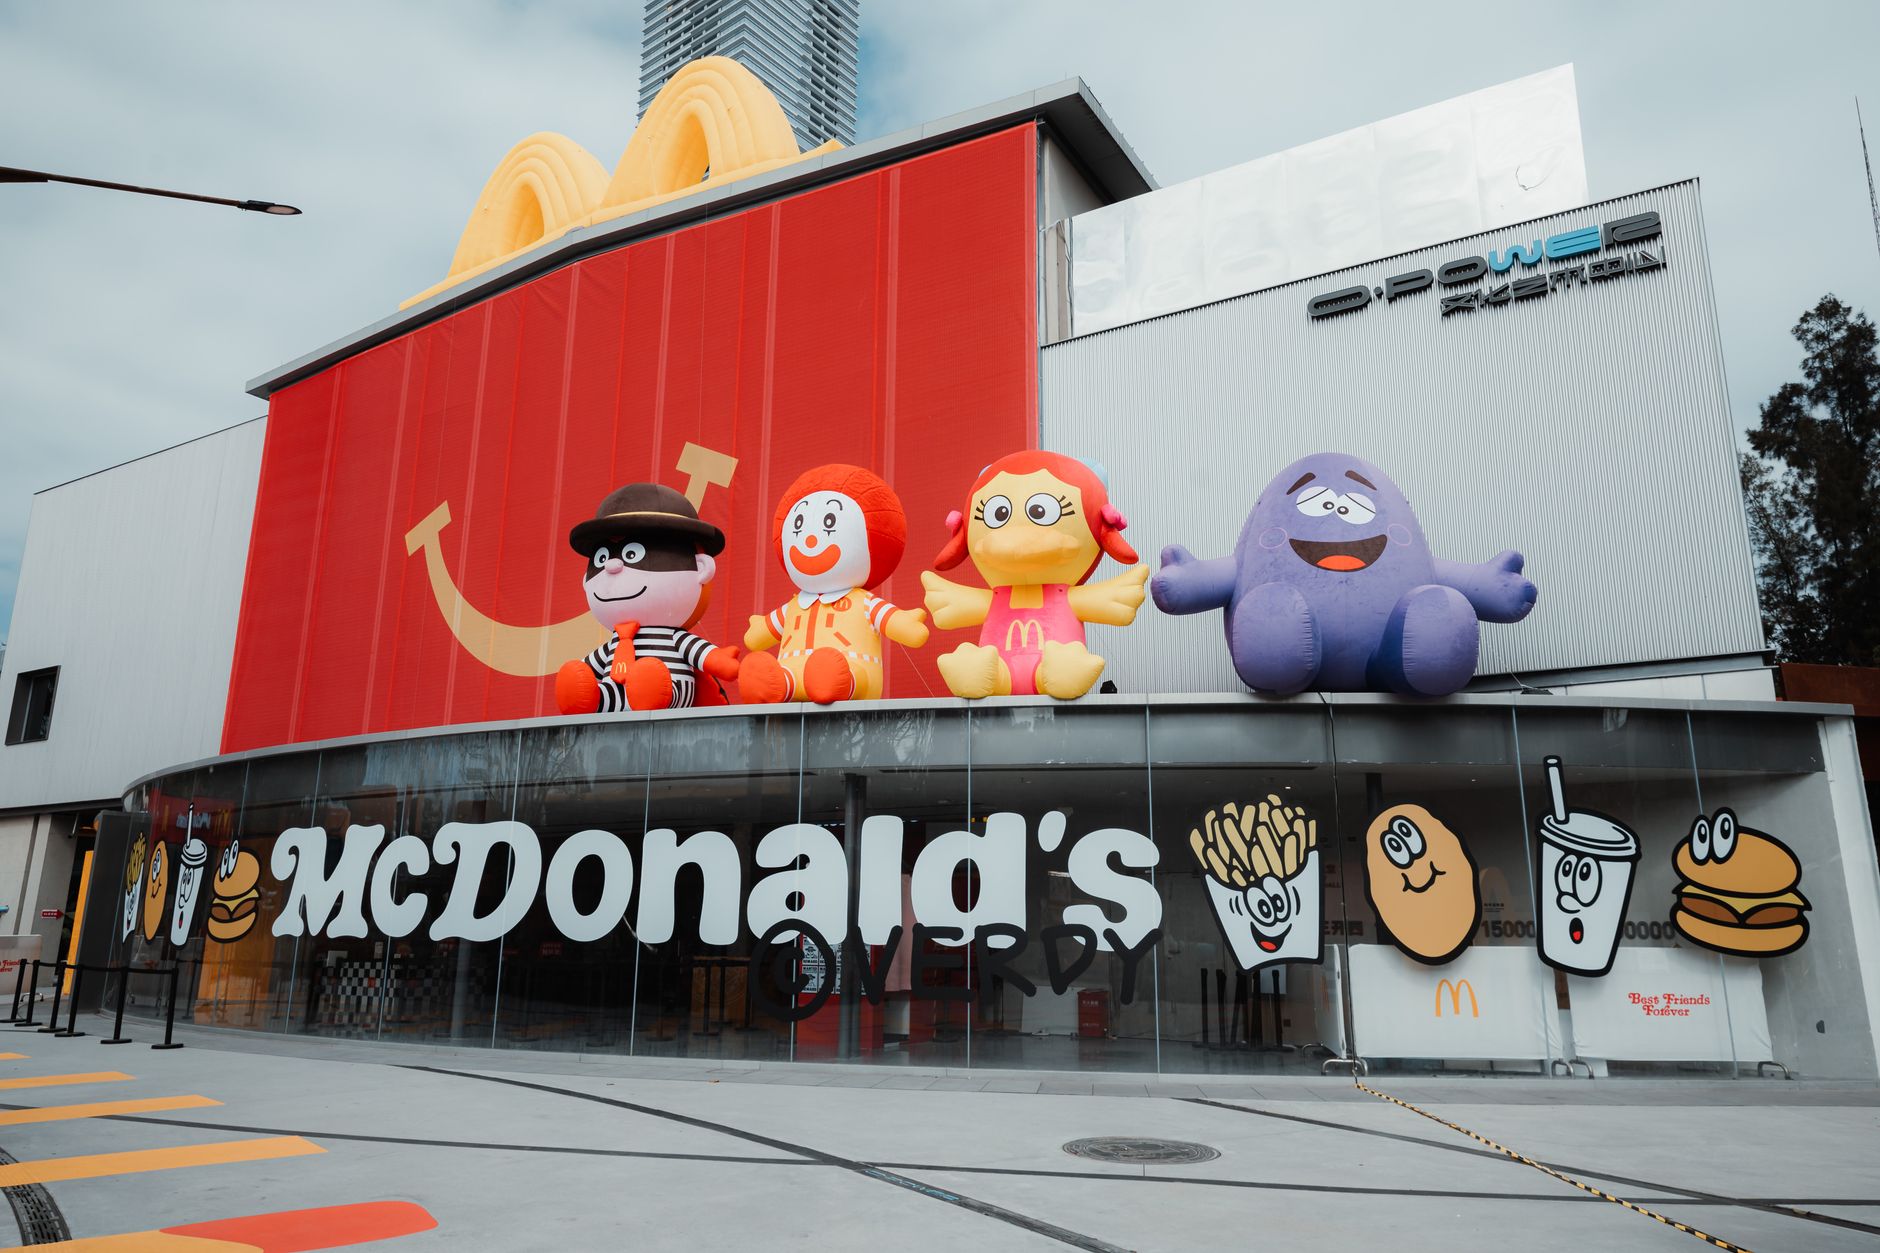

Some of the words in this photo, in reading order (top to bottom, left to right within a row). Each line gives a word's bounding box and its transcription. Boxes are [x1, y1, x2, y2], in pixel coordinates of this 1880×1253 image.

[271, 811, 1163, 952] McDonald's
[1628, 992, 1660, 1005] Best
[1662, 993, 1711, 1006] Friends
[1642, 1004, 1691, 1016] Forever
